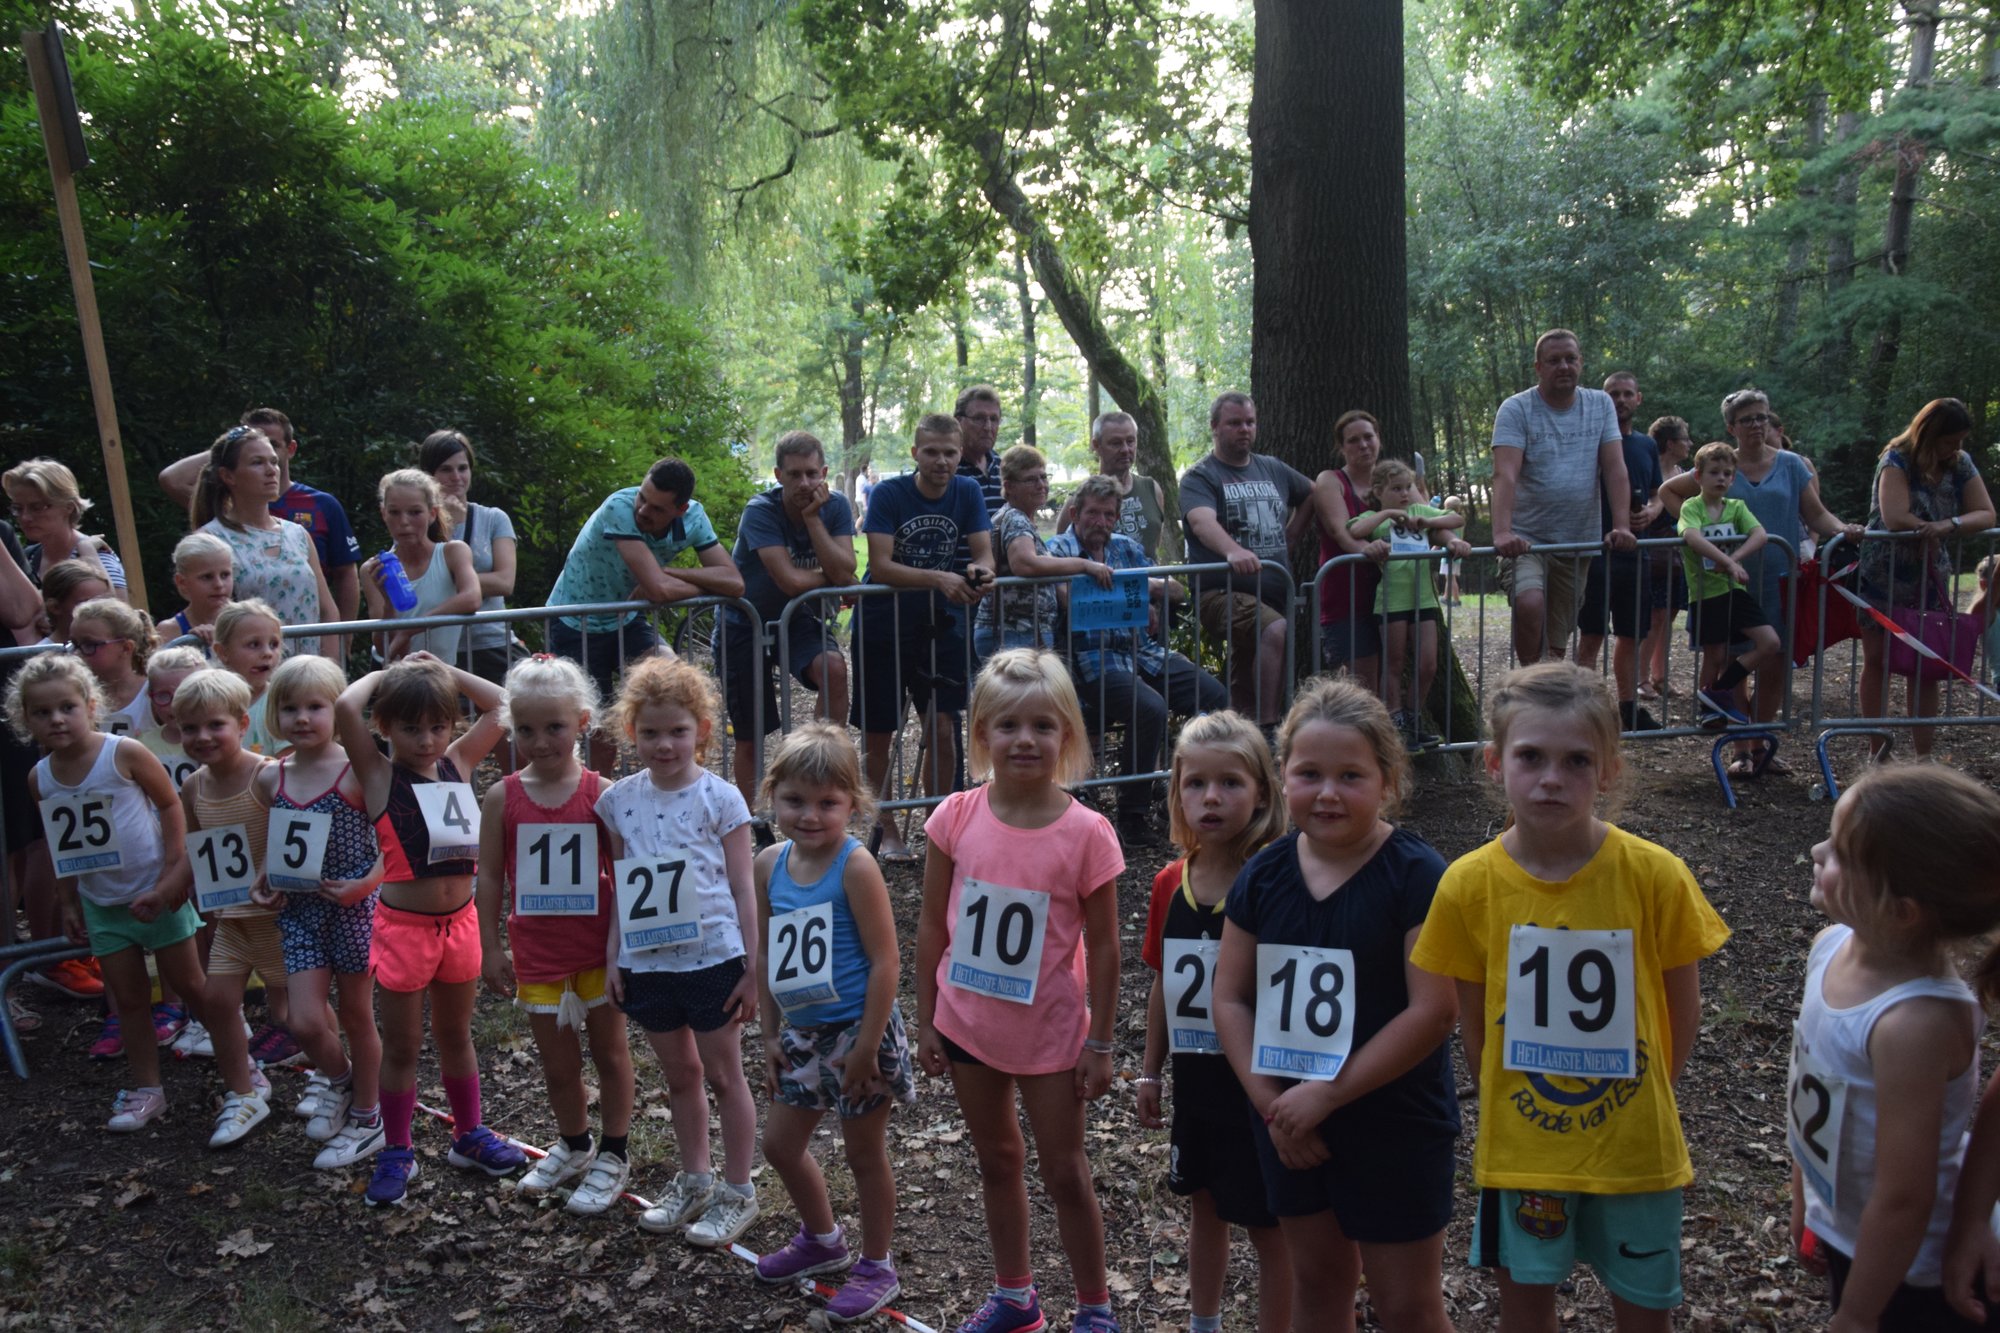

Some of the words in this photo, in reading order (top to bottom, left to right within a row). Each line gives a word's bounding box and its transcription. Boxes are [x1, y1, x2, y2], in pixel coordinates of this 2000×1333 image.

[1223, 482, 1279, 500] HONGKON
[52, 801, 111, 852] 25
[443, 791, 471, 835] 4
[197, 833, 249, 882] 13
[283, 820, 311, 869] 5
[529, 833, 581, 886] 11
[524, 896, 537, 909] HET
[538, 896, 565, 909] LAATSTE
[566, 896, 592, 909] NIEUWS
[626, 860, 686, 921] 27
[628, 932, 642, 946] HET
[776, 916, 827, 982] 26
[966, 895, 1034, 966] 10
[954, 964, 969, 982] HET
[969, 968, 997, 991] LAATSTE
[997, 975, 1028, 997] NIEUWS
[1174, 953, 1217, 1020] 2
[1270, 958, 1344, 1038] 18
[1519, 946, 1617, 1033] 19
[1177, 1030, 1193, 1046] HET
[1262, 1047, 1280, 1067] HET
[1280, 1048, 1313, 1072] LAATSTE
[1516, 1042, 1537, 1064] HET
[1537, 1045, 1582, 1070] LAATSTE
[1583, 1050, 1625, 1072] NIEUWS
[1510, 1087, 1572, 1134] Ronde
[1580, 1096, 1613, 1131] van
